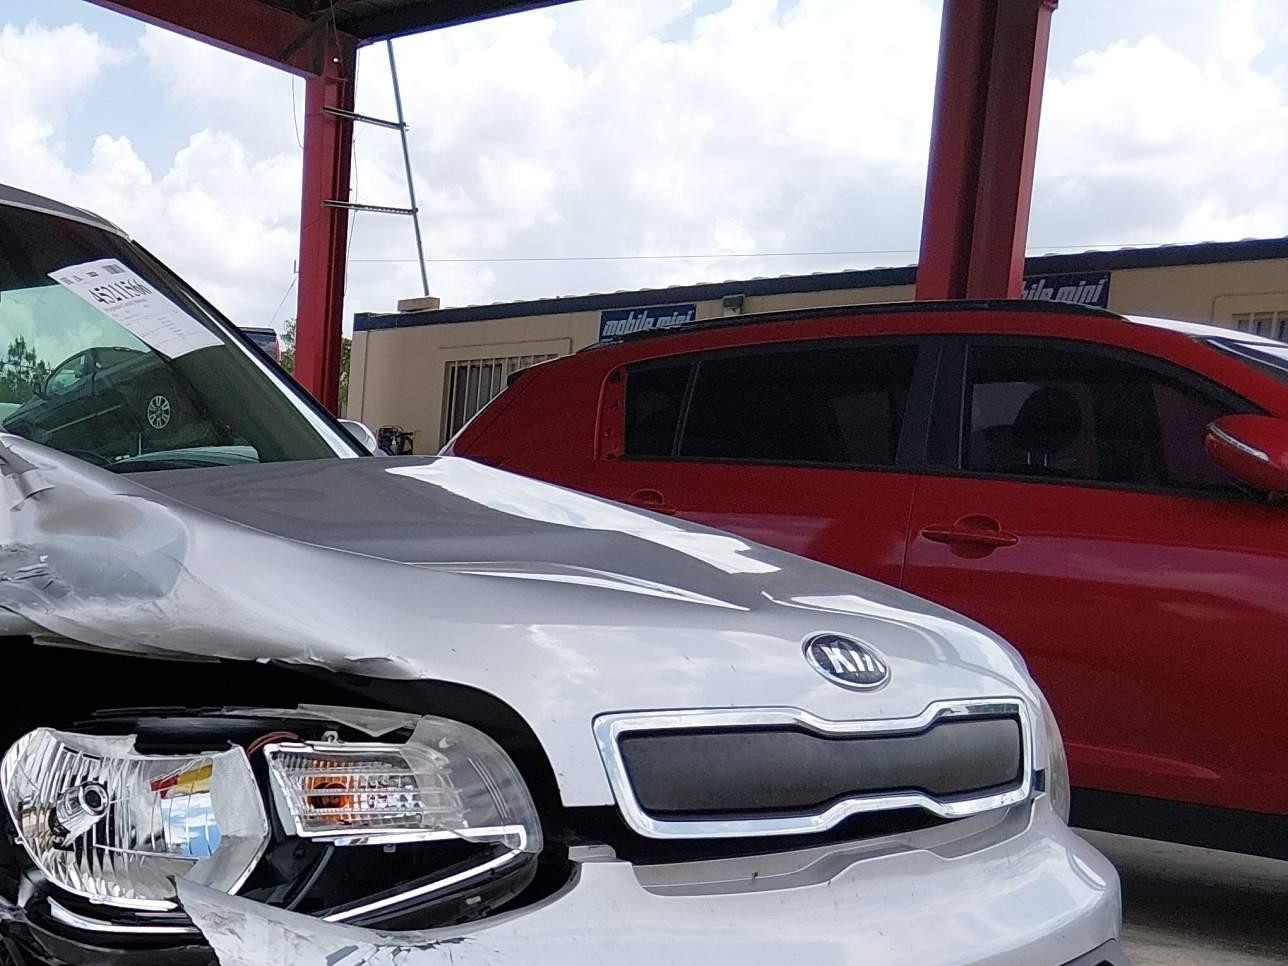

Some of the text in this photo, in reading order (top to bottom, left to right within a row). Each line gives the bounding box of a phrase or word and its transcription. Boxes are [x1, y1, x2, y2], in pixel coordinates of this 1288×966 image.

[88, 278, 153, 304] 45211566
[1055, 279, 1105, 304] mini
[602, 310, 654, 336] mobile
[818, 644, 886, 673] KIA
